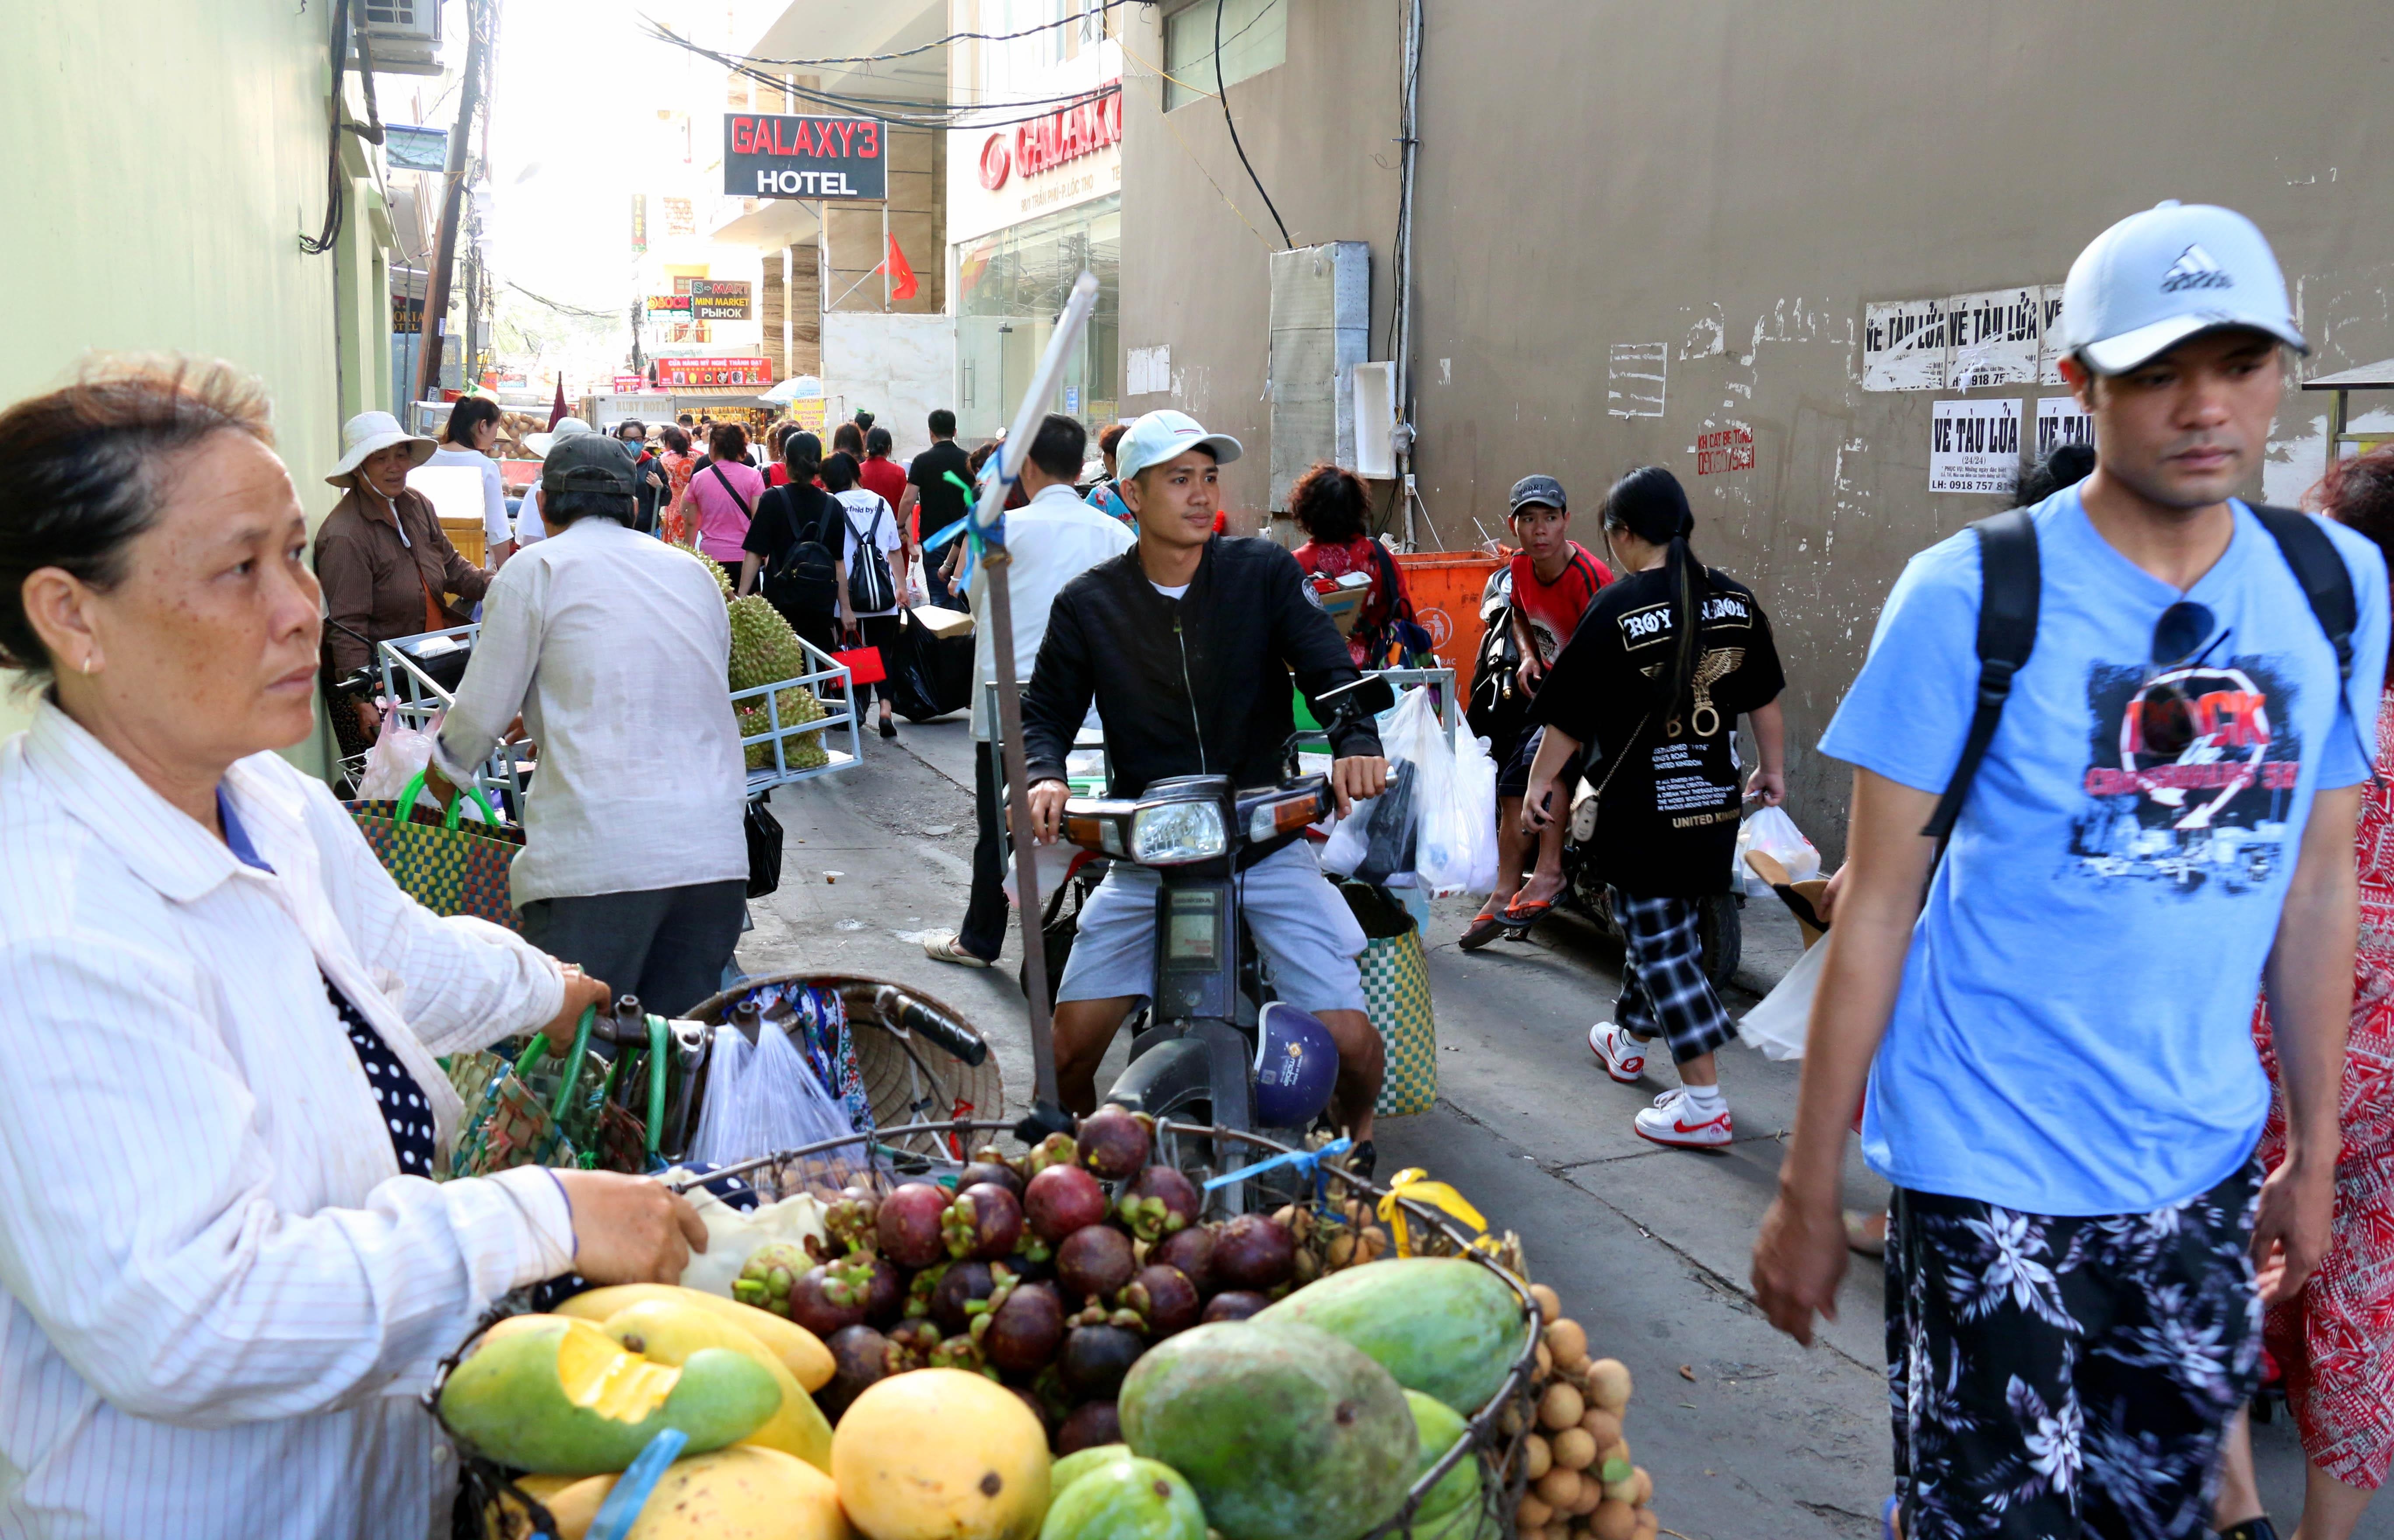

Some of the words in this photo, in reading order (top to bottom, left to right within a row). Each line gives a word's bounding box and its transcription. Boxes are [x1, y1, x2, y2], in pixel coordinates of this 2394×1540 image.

[732, 117, 879, 158] GALAXY3
[757, 170, 858, 195] HOTEL
[1082, 174, 1093, 193] THỌ
[712, 284, 750, 294] MART
[695, 298, 713, 306] MINI
[715, 298, 749, 306] MARKET
[701, 308, 742, 318] РЫНОК
[1950, 302, 1968, 346] VÉ
[1974, 300, 2003, 344] TÀU
[2007, 292, 2037, 341] LỬA
[1970, 374, 1989, 386] 918
[616, 401, 640, 412] RUBY
[644, 401, 668, 412] HOTE
[1935, 409, 1952, 452] VÉ
[1956, 408, 1985, 453] TÀU
[1989, 402, 2017, 453] LỬA
[2039, 407, 2058, 453] VÉ
[1710, 432, 1721, 448] CAT
[1723, 431, 1731, 445] BE
[1962, 456, 1986, 465] (24/24)
[1932, 480, 1946, 489] LH:
[1950, 481, 1973, 489] 0918
[1976, 481, 1993, 490] 757
[1624, 609, 1673, 639] BOY
[1672, 813, 1714, 828] UNITED
